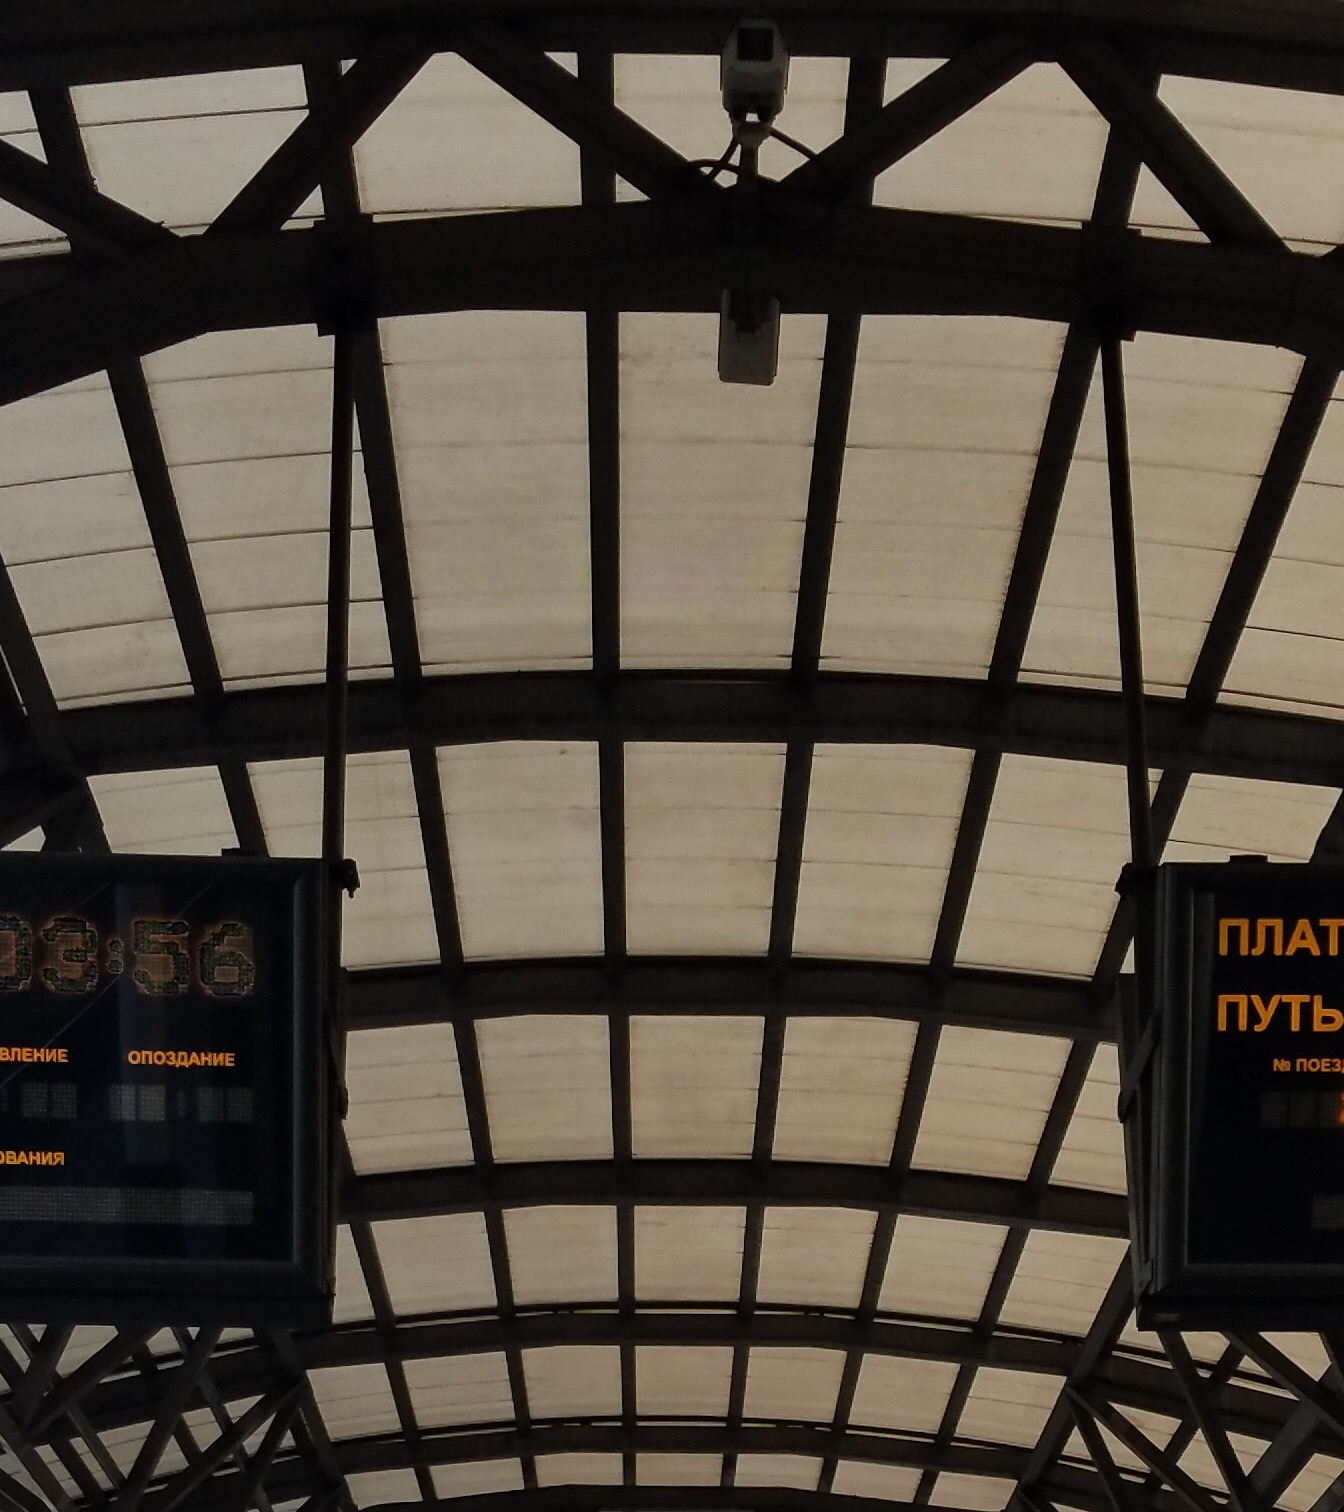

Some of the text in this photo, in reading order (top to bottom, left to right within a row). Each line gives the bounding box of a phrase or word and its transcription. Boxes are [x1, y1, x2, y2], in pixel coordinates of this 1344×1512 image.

[1216, 993, 1344, 1033] ПУТЬ
[127, 1050, 235, 1068] ОПОЗДАНИЕ
[1272, 1057, 1292, 1072] №
